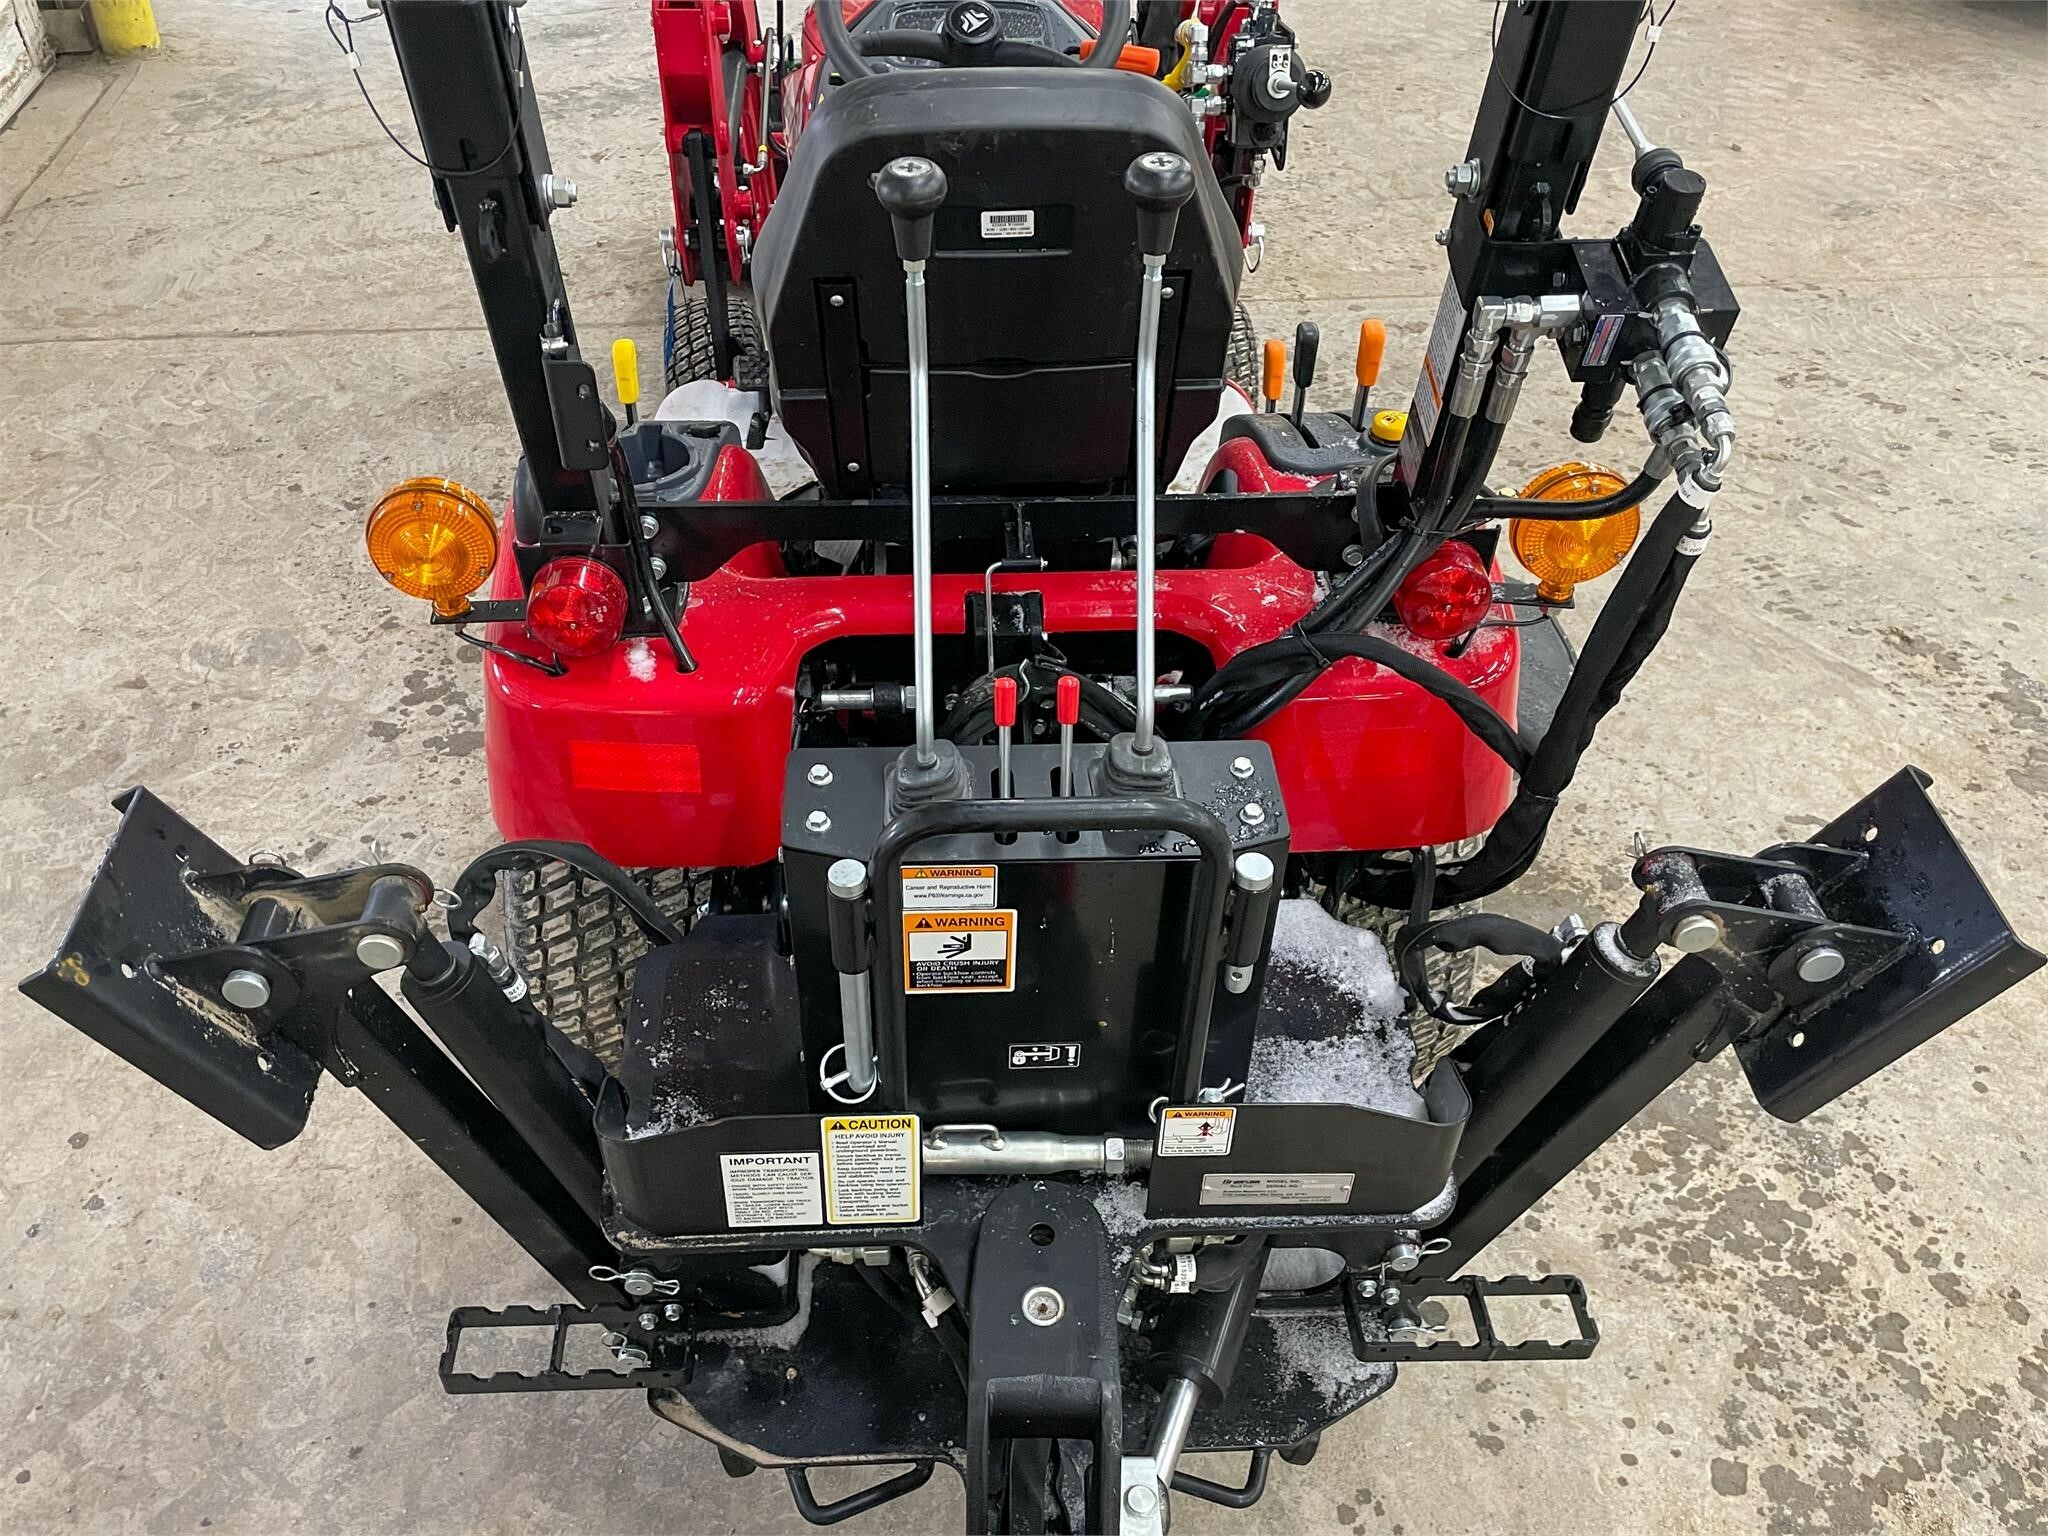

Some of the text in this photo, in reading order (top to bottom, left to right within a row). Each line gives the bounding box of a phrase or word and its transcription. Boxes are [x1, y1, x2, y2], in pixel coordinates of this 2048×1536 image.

[934, 917, 1005, 927] WARNING
[848, 1118, 911, 1130] CAUTION
[729, 1157, 811, 1166] IMPORTANT
